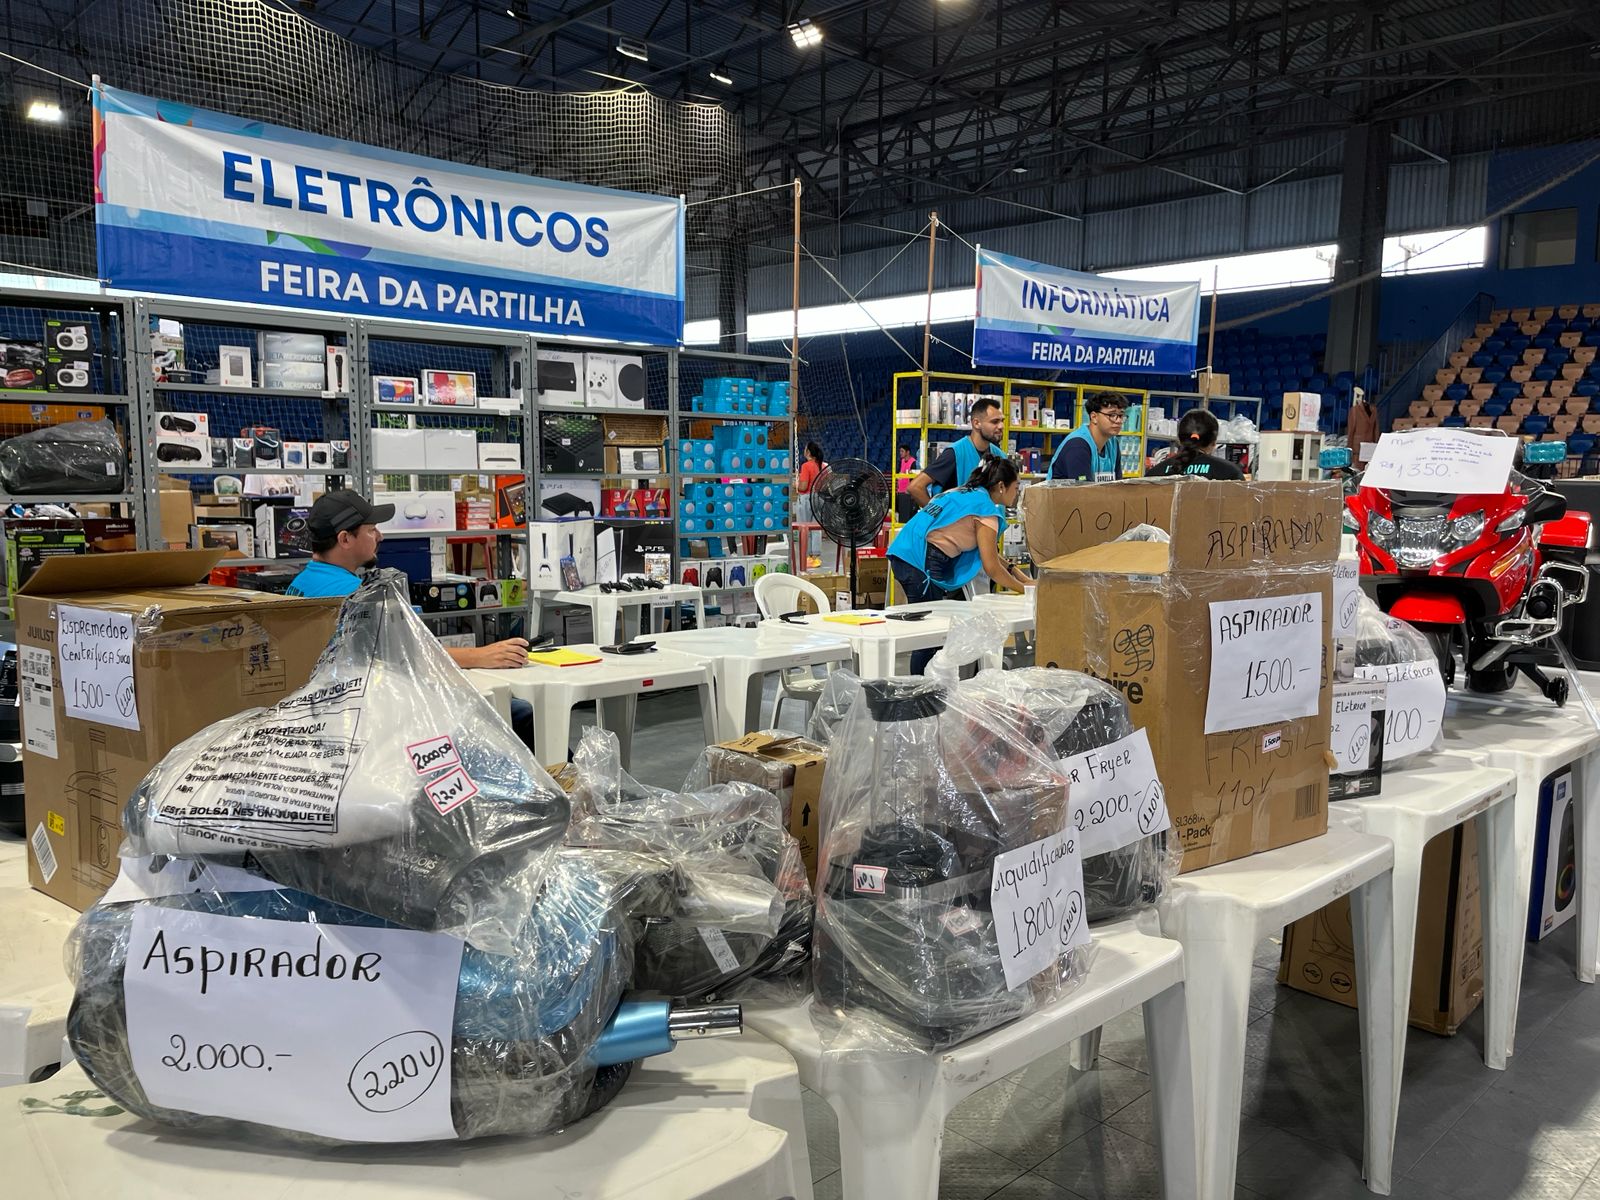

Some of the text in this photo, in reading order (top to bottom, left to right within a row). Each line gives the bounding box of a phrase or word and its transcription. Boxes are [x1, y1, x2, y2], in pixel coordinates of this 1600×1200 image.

[222, 150, 610, 259] ELETRÔNICOS
[260, 260, 586, 328] FEIRA DA PARTILHA
[1021, 279, 1170, 323] INFORMÁTICA
[1031, 341, 1156, 367] FEIRA DA PARTILHA
[645, 544, 665, 553] PS5
[1204, 511, 1325, 569] ASPIRADOR
[1219, 603, 1315, 645] ASPIRADOR
[189, 806, 229, 817] BOLSA
[431, 777, 464, 806] 220V
[1216, 767, 1277, 817] 110V
[363, 1045, 437, 1099] 220V
